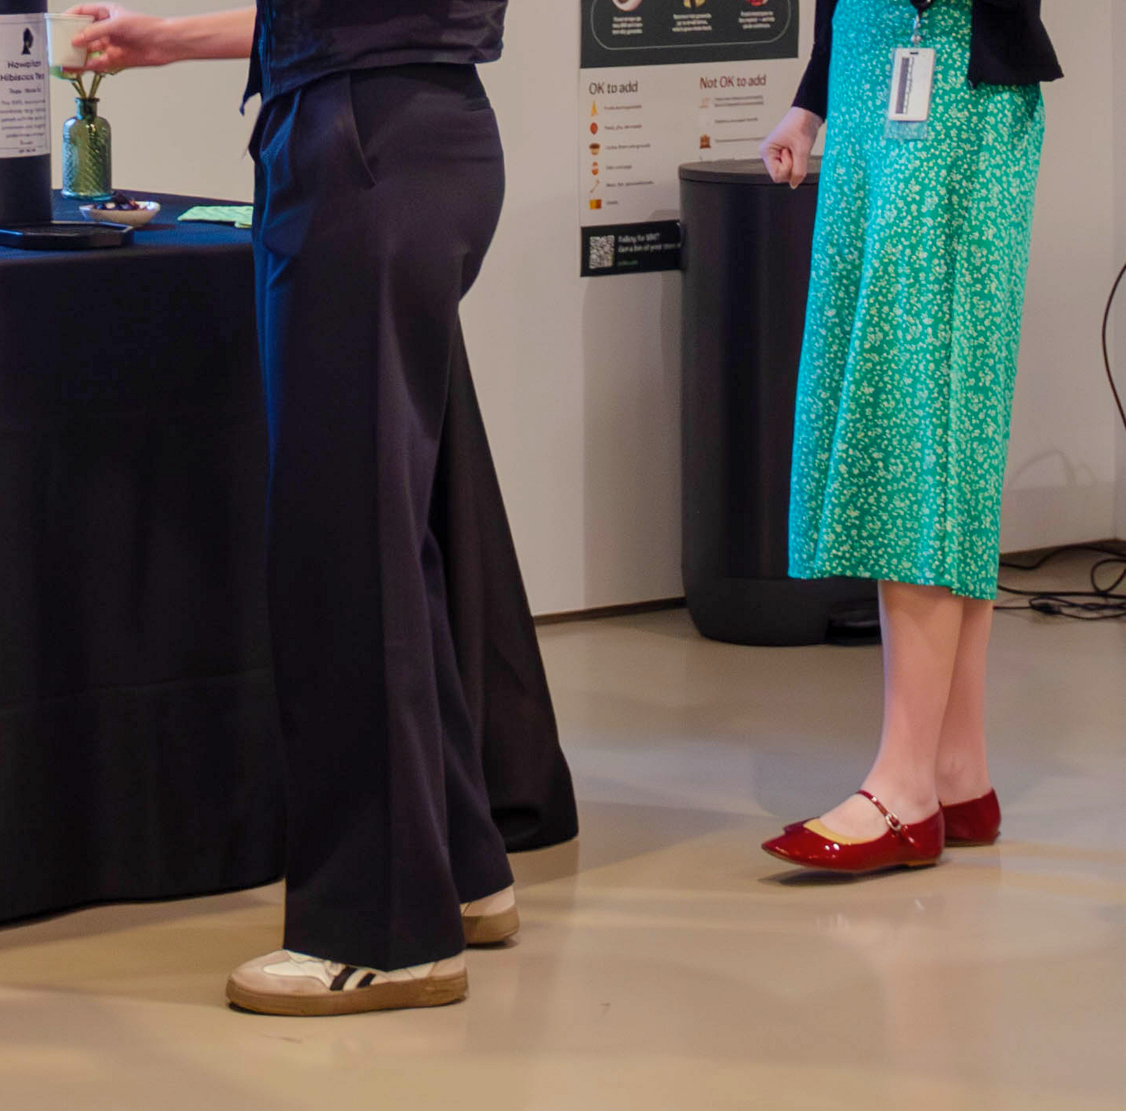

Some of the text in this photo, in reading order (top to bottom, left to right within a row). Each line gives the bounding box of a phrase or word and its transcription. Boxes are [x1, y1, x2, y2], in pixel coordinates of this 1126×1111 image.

[589, 81, 639, 95] OK to add
[699, 74, 767, 89] Not OK to add
